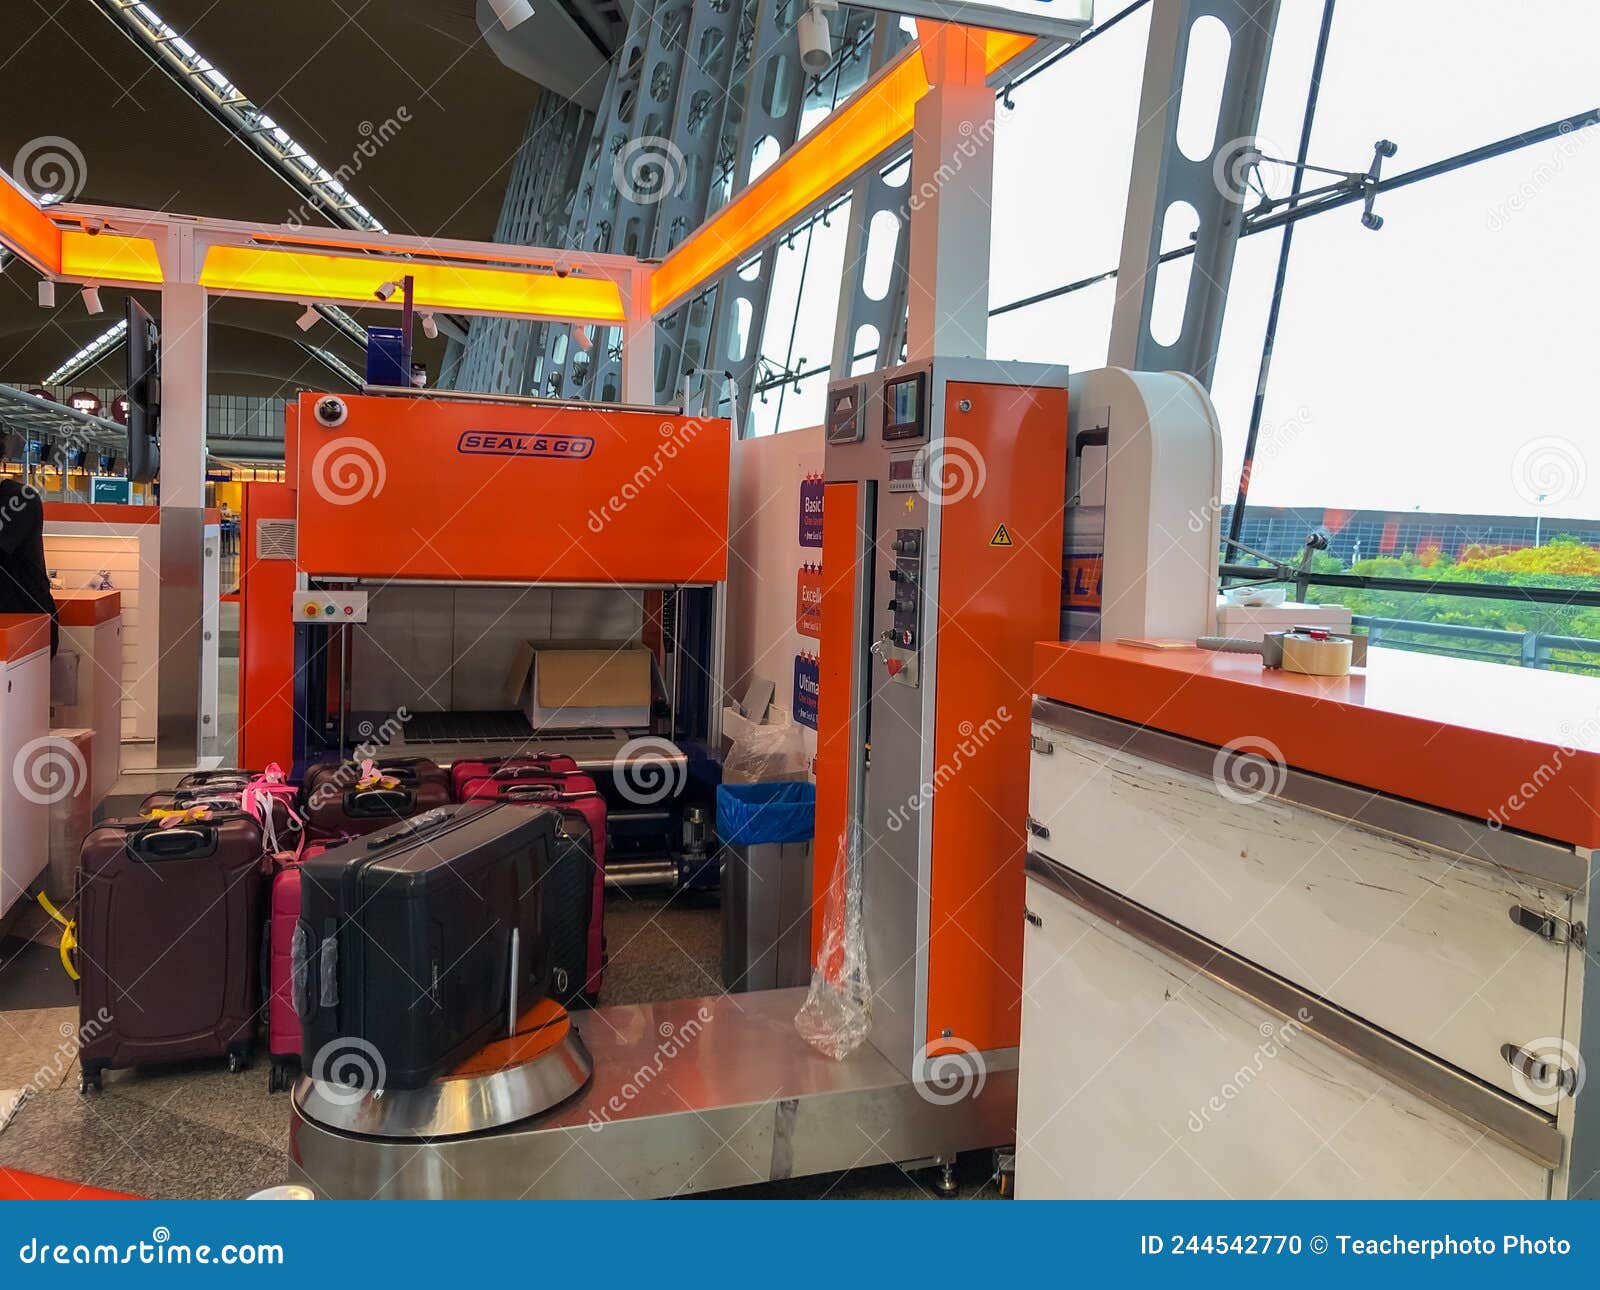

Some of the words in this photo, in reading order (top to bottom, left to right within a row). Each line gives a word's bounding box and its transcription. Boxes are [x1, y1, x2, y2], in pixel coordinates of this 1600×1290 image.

[465, 436, 527, 450] SEAL
[533, 439, 548, 451] &
[553, 440, 587, 453] GO
[805, 496, 821, 513] Basic
